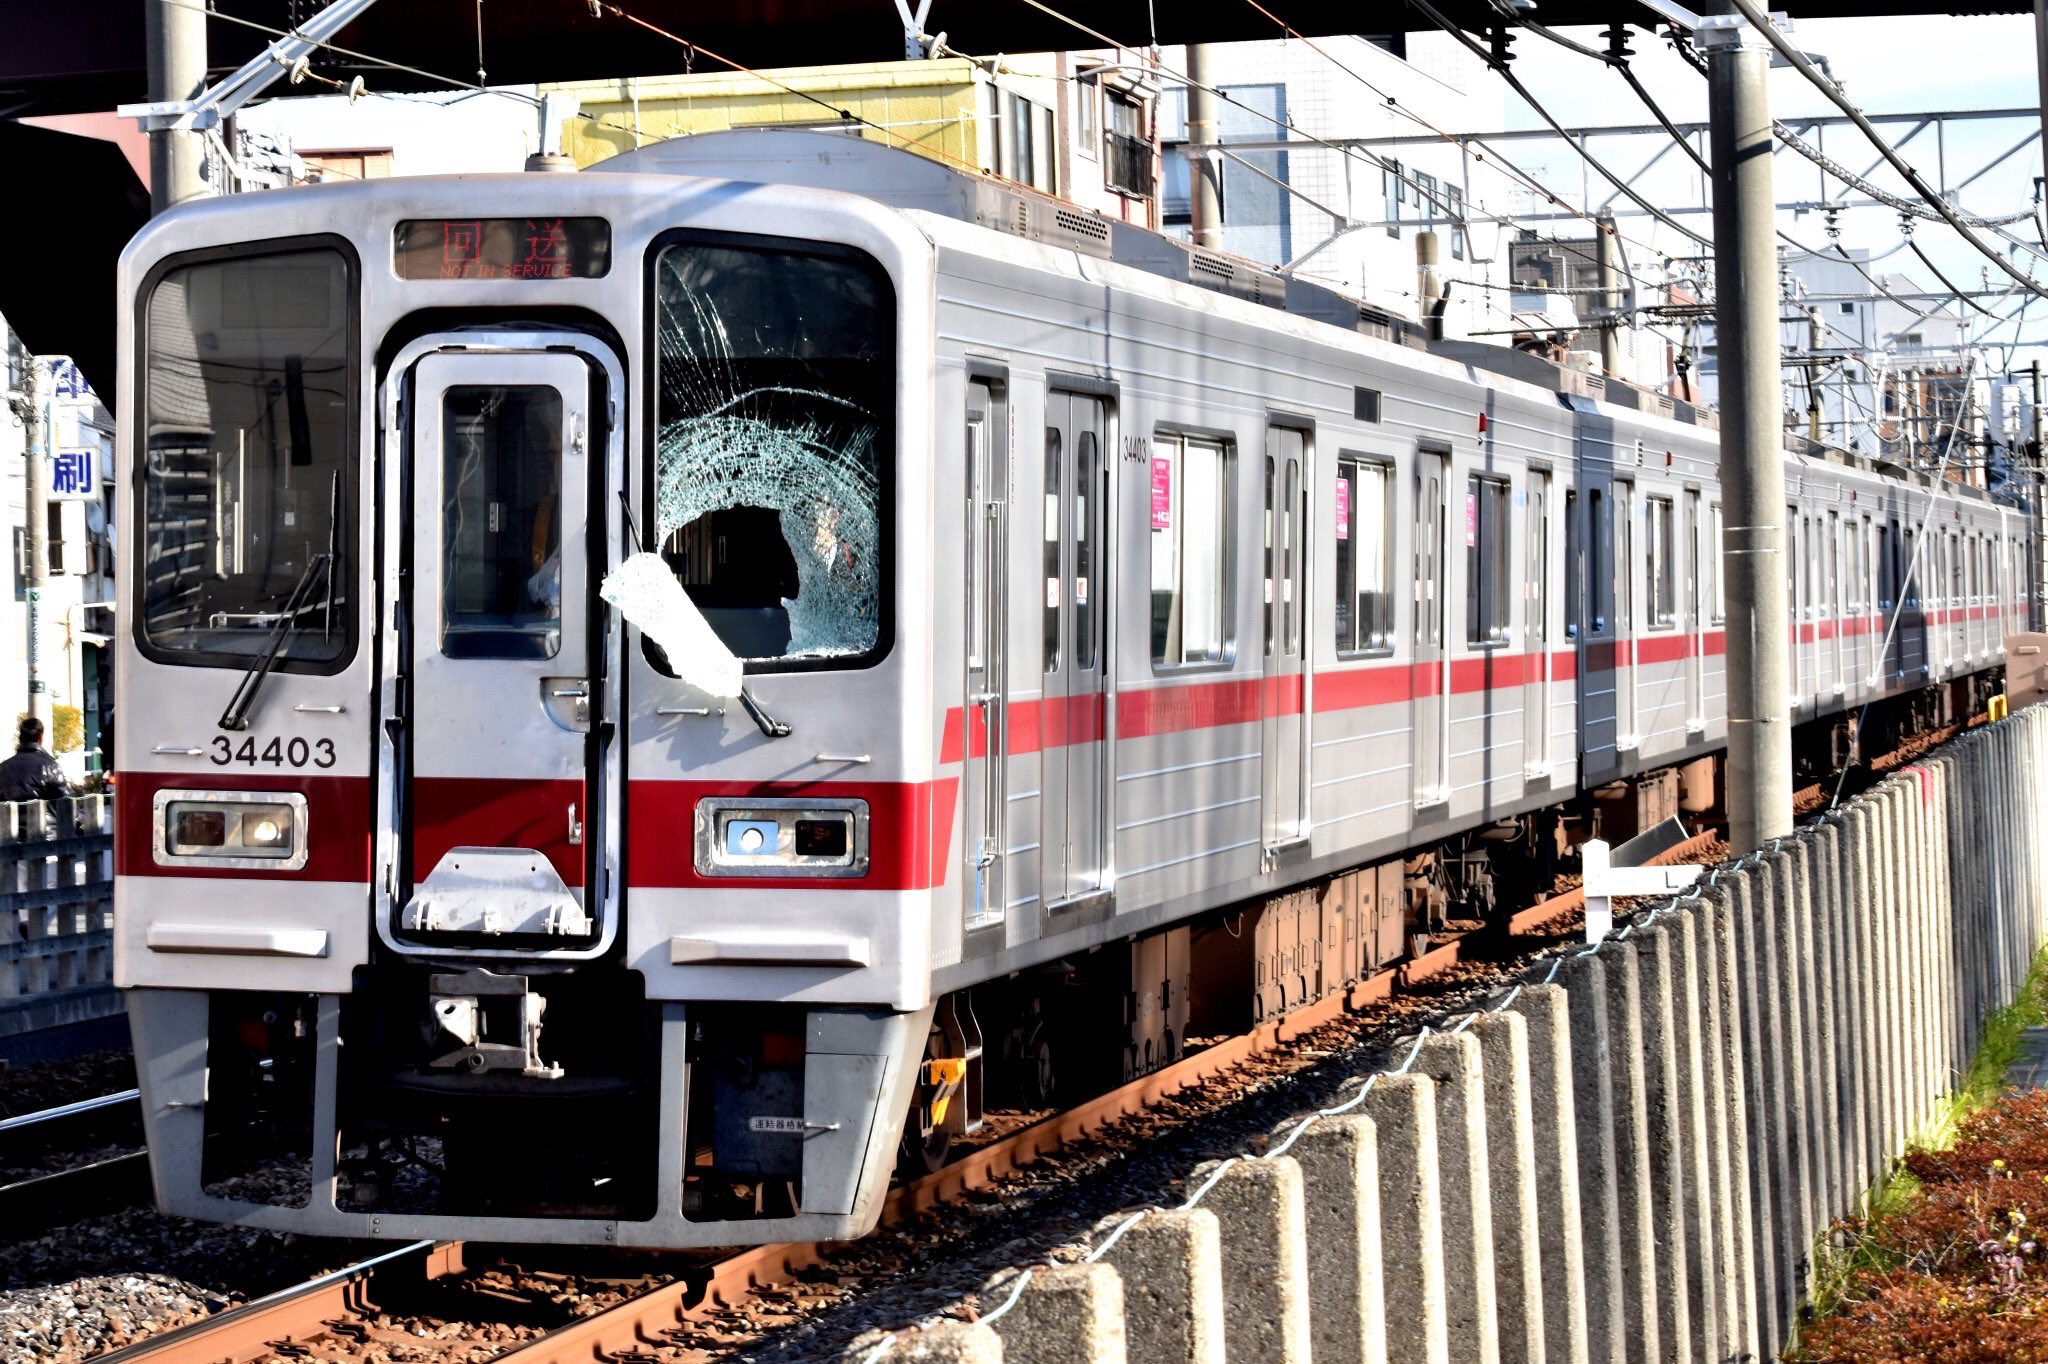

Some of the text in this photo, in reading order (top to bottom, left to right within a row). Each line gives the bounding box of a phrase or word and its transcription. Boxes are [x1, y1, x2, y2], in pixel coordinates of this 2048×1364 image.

[443, 220, 567, 263] 回送
[441, 263, 571, 278] NOT IN SERVICE
[1123, 435, 1147, 464] 34403
[210, 735, 336, 768] 34403
